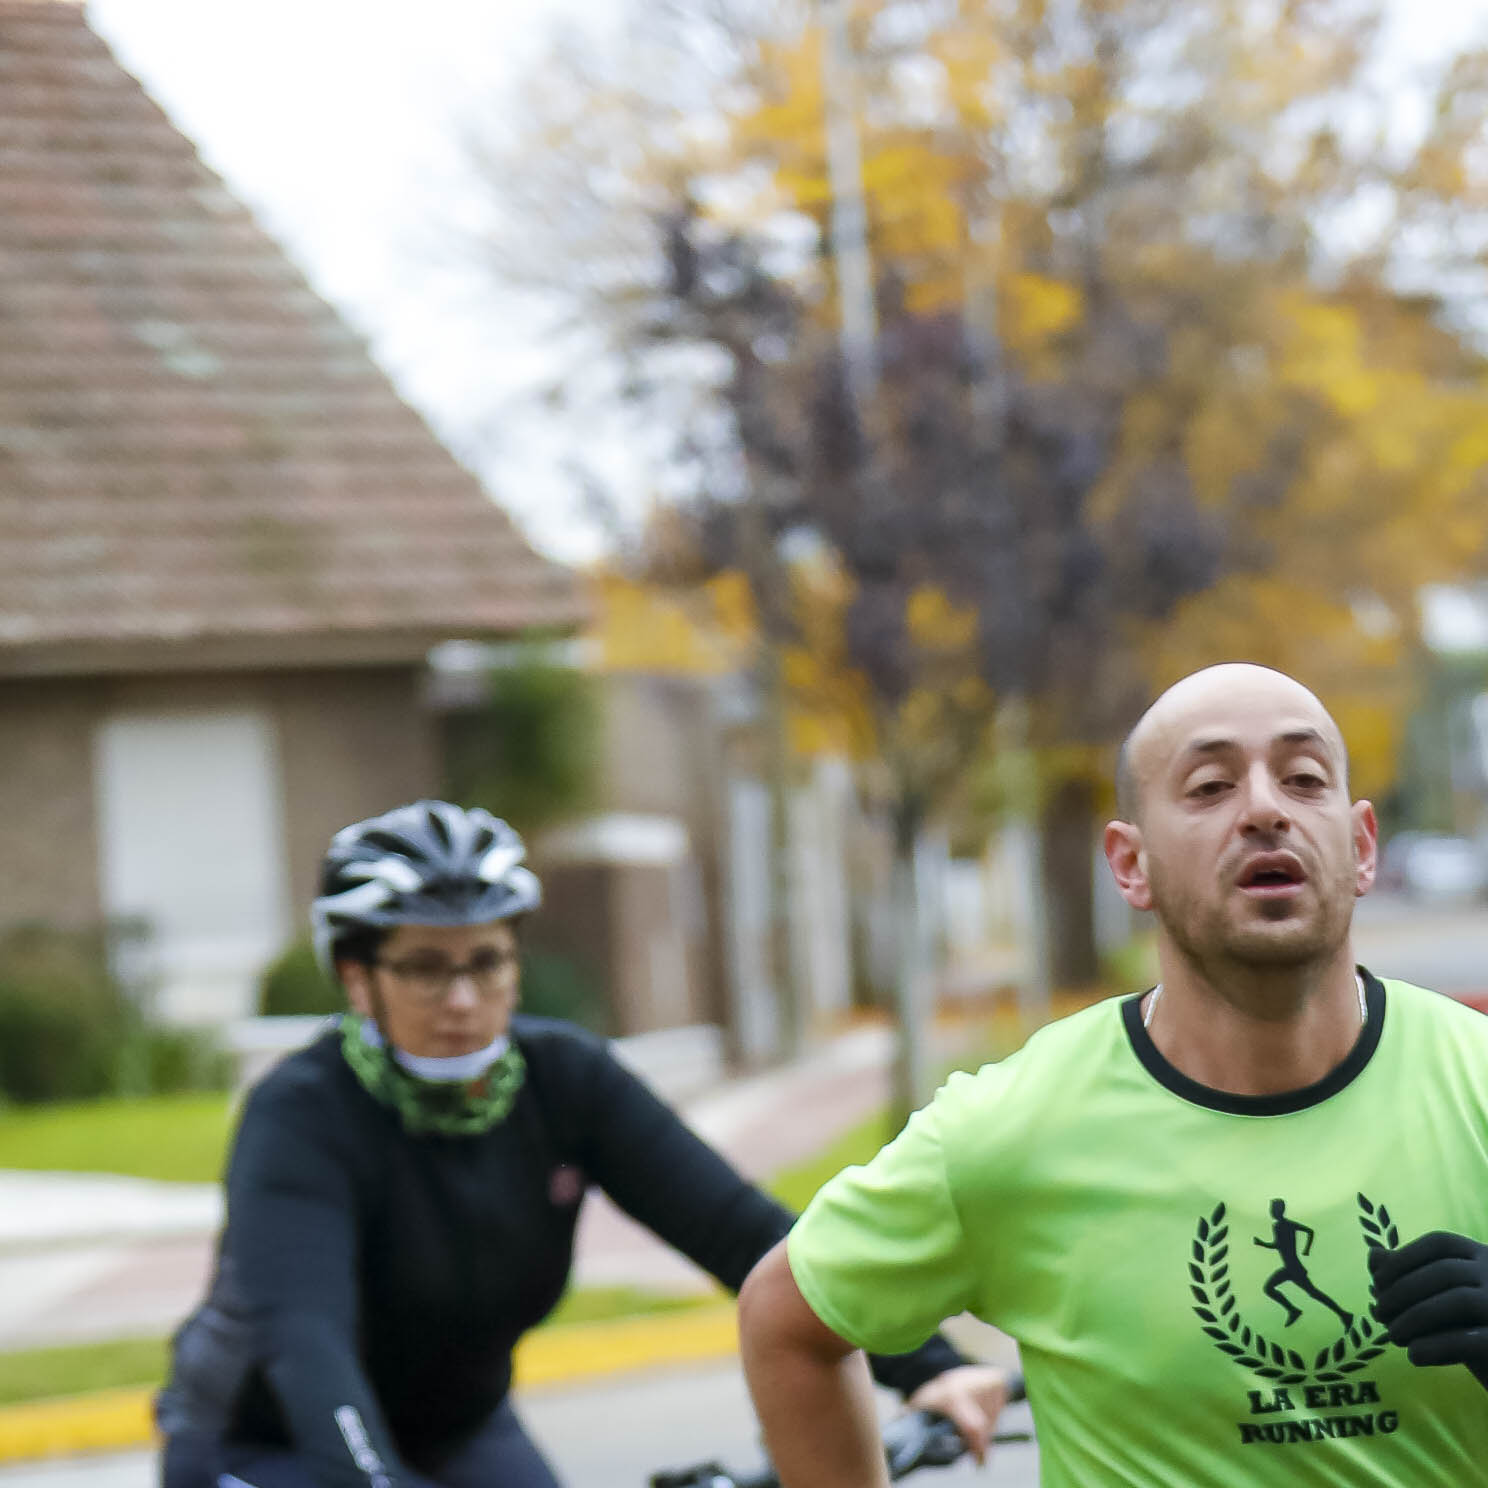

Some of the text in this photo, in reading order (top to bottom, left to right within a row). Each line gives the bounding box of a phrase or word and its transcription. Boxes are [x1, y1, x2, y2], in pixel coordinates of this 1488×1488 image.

[1248, 1381, 1380, 1414] LA ERA
[1239, 1411, 1398, 1444] RUNNING
